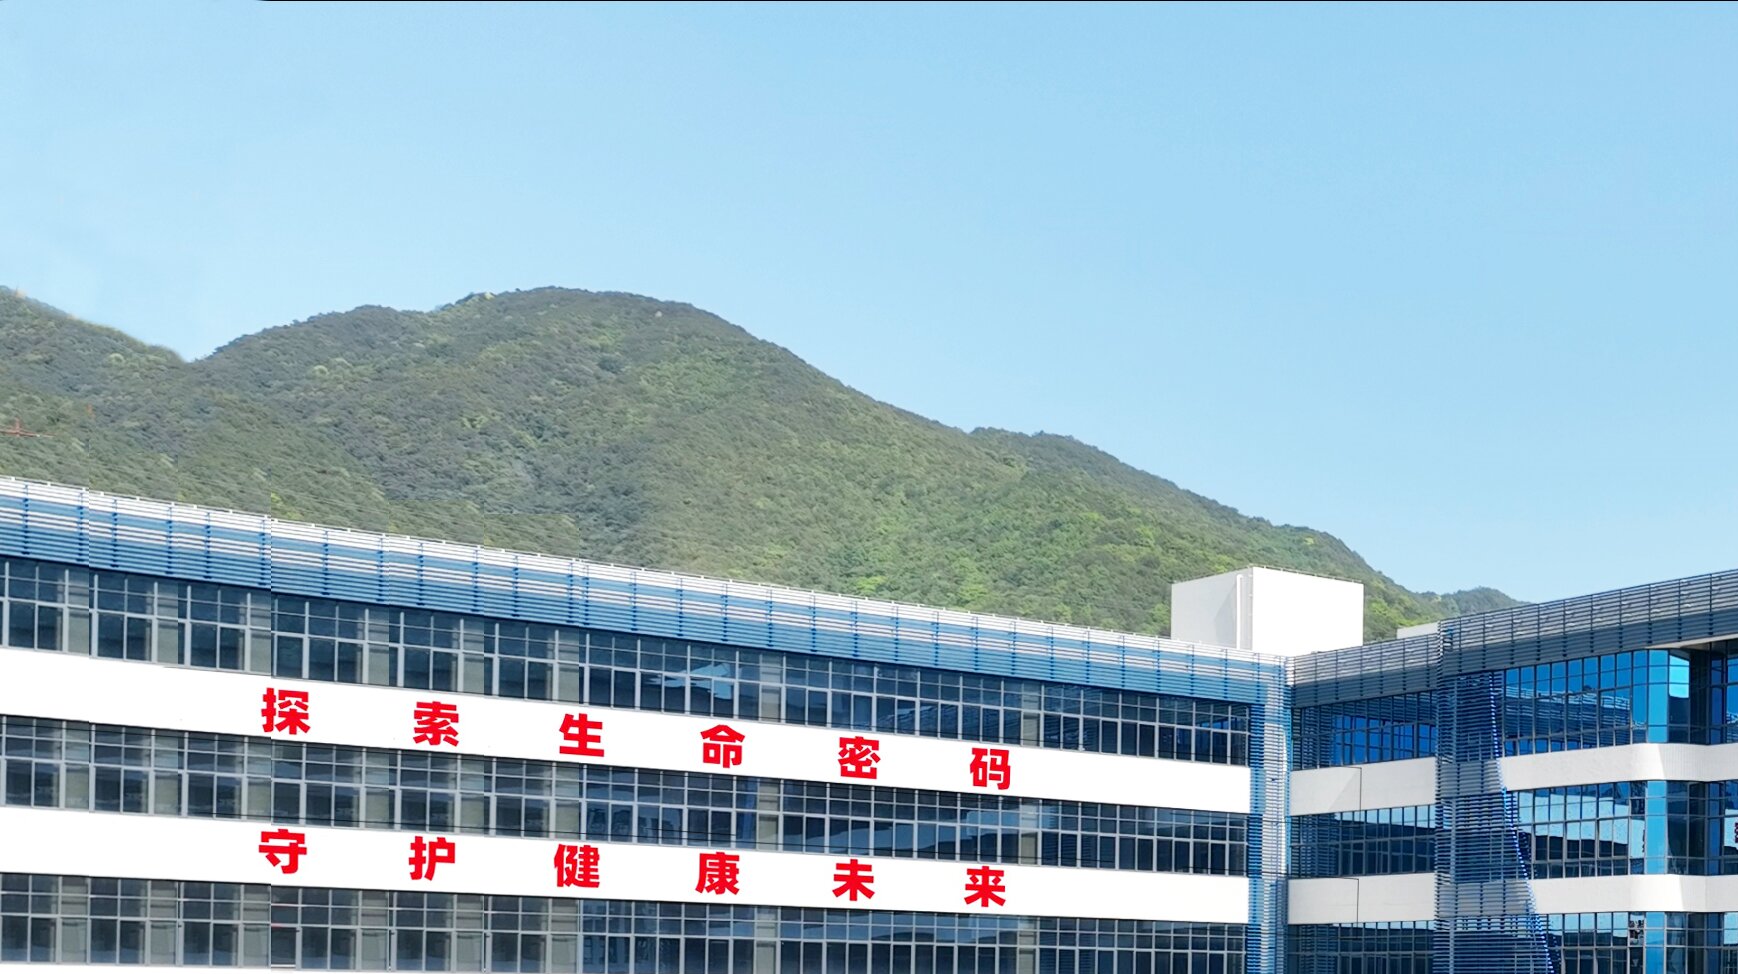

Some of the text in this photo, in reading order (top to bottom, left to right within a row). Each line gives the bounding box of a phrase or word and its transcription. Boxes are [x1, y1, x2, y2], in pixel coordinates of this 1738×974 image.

[261, 687, 1011, 791] 探索生命密码
[258, 828, 1006, 908] 守护健康未来
